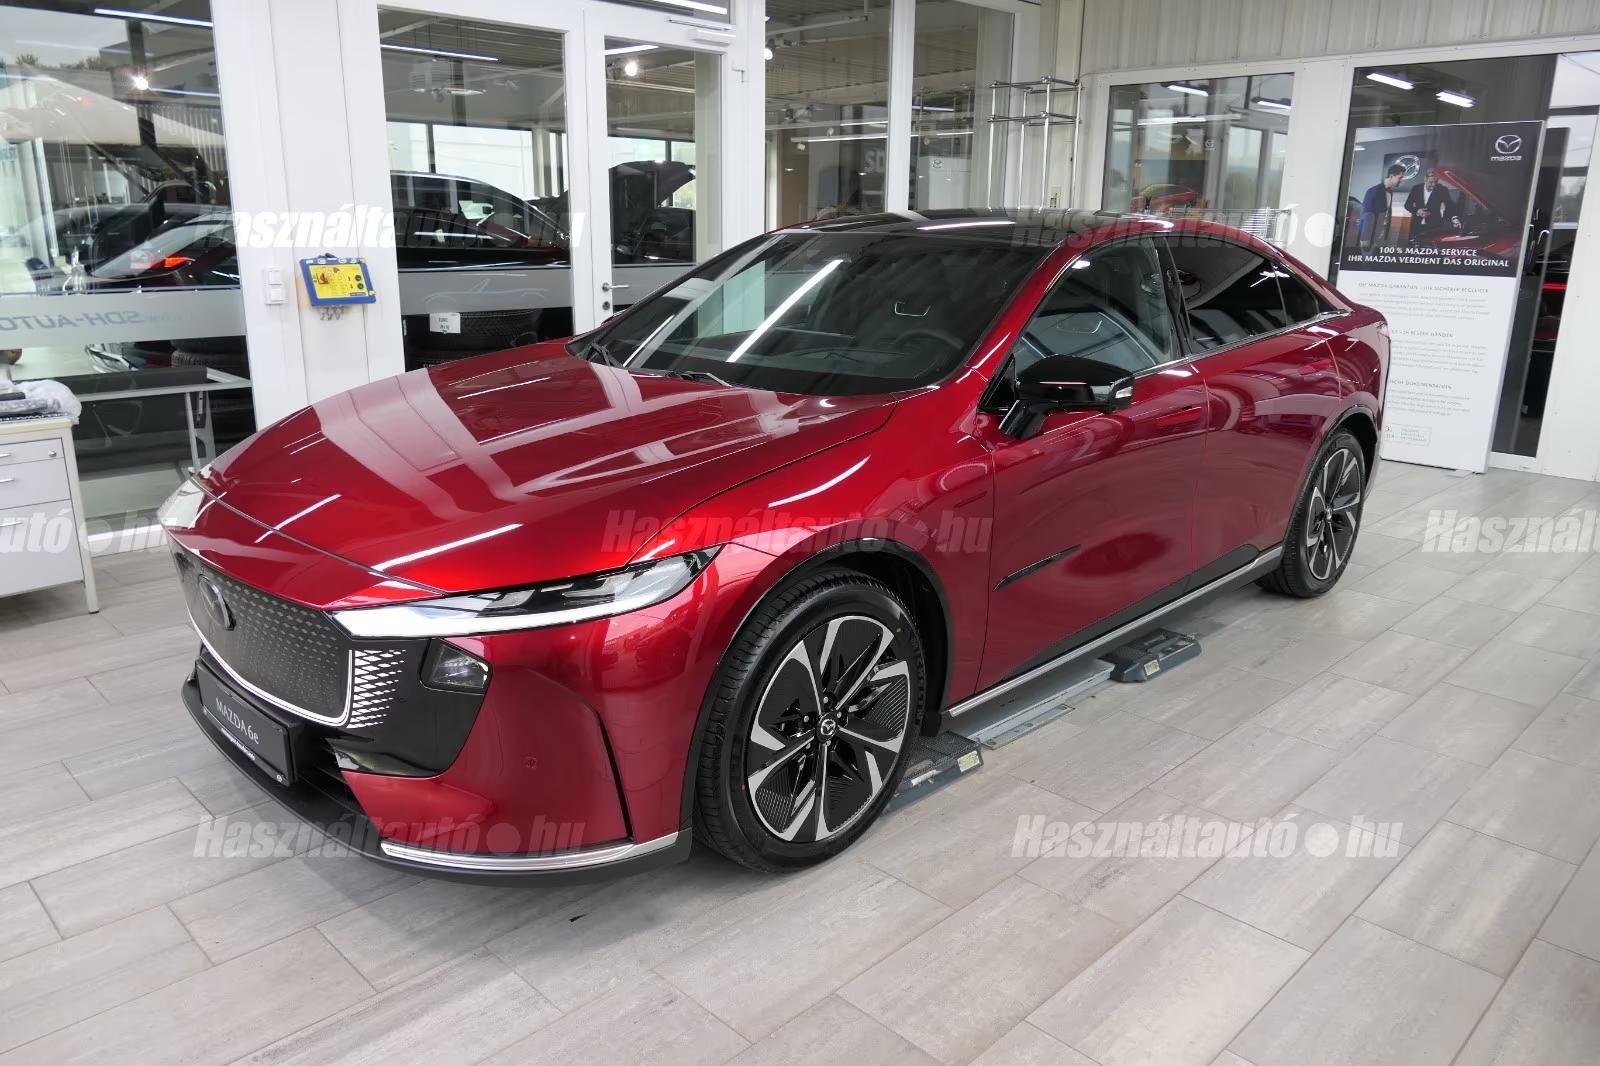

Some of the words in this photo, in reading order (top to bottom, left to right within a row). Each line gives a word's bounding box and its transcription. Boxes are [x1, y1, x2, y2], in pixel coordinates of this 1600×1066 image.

[1379, 247, 1395, 255] 100
[1405, 247, 1438, 256] MAZDA
[1440, 248, 1478, 257] SERVICE
[1348, 255, 1363, 263] IHR
[1364, 255, 1397, 264] MAZDA
[1398, 256, 1441, 266] VERDIENT
[1443, 258, 1462, 267] DAS
[1463, 258, 1510, 268] ORIGINAL
